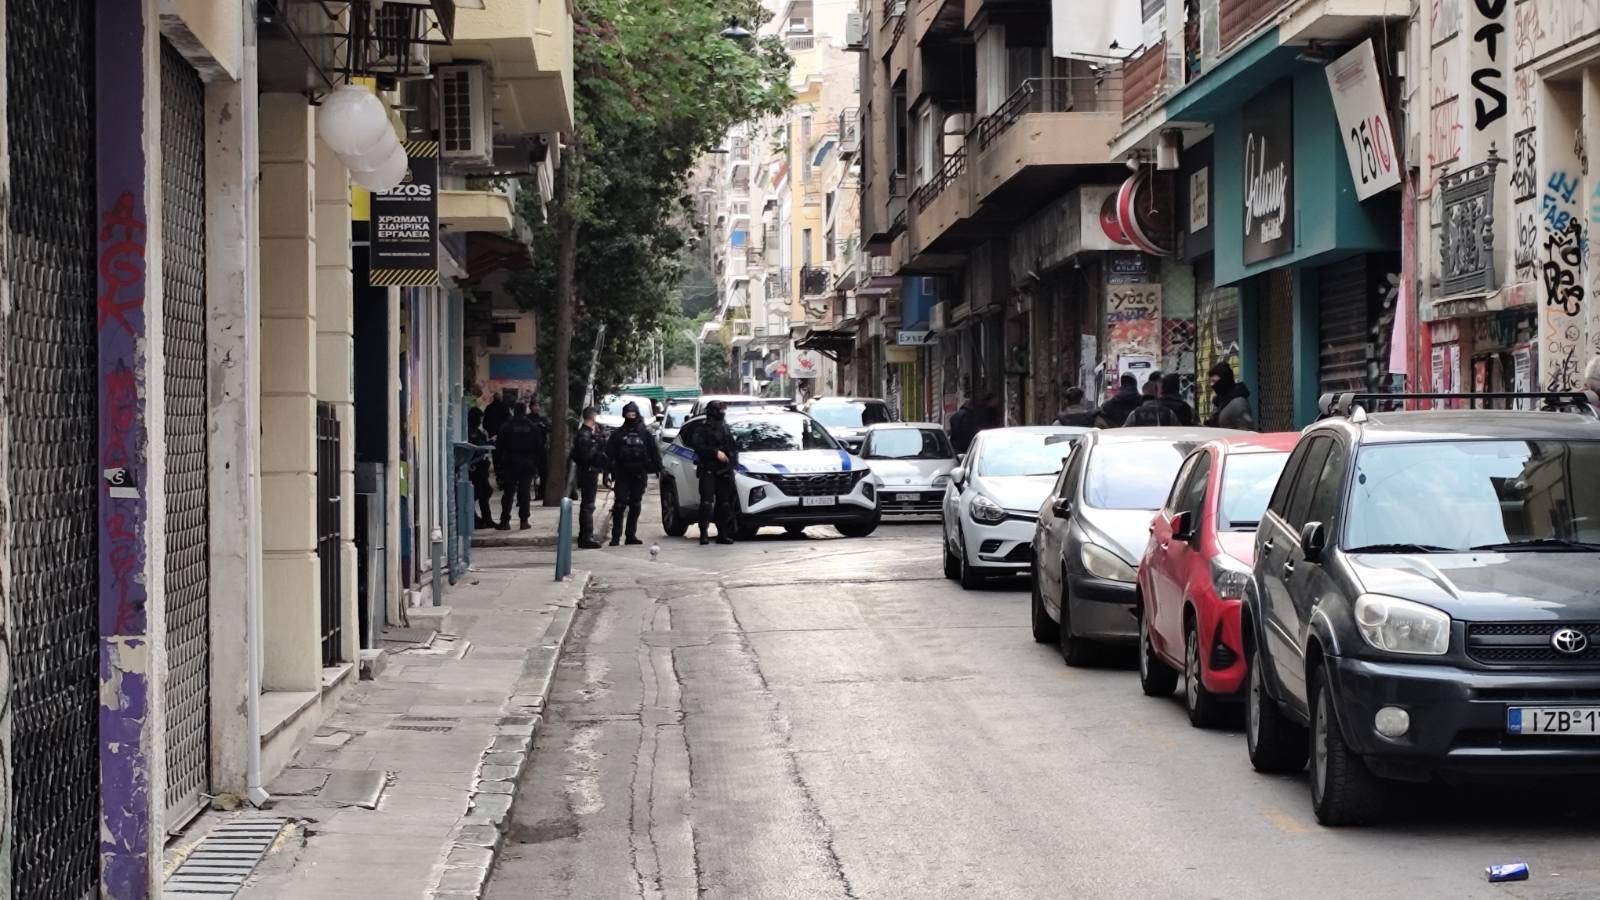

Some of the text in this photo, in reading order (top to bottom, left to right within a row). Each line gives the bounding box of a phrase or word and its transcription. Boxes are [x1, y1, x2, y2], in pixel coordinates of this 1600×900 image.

[378, 215, 430, 223] ΧΡΩΜΑΤΑ
[378, 230, 430, 238] ΕΡΓΑΛΕΙΑ
[1533, 711, 1600, 732] IZB-1
